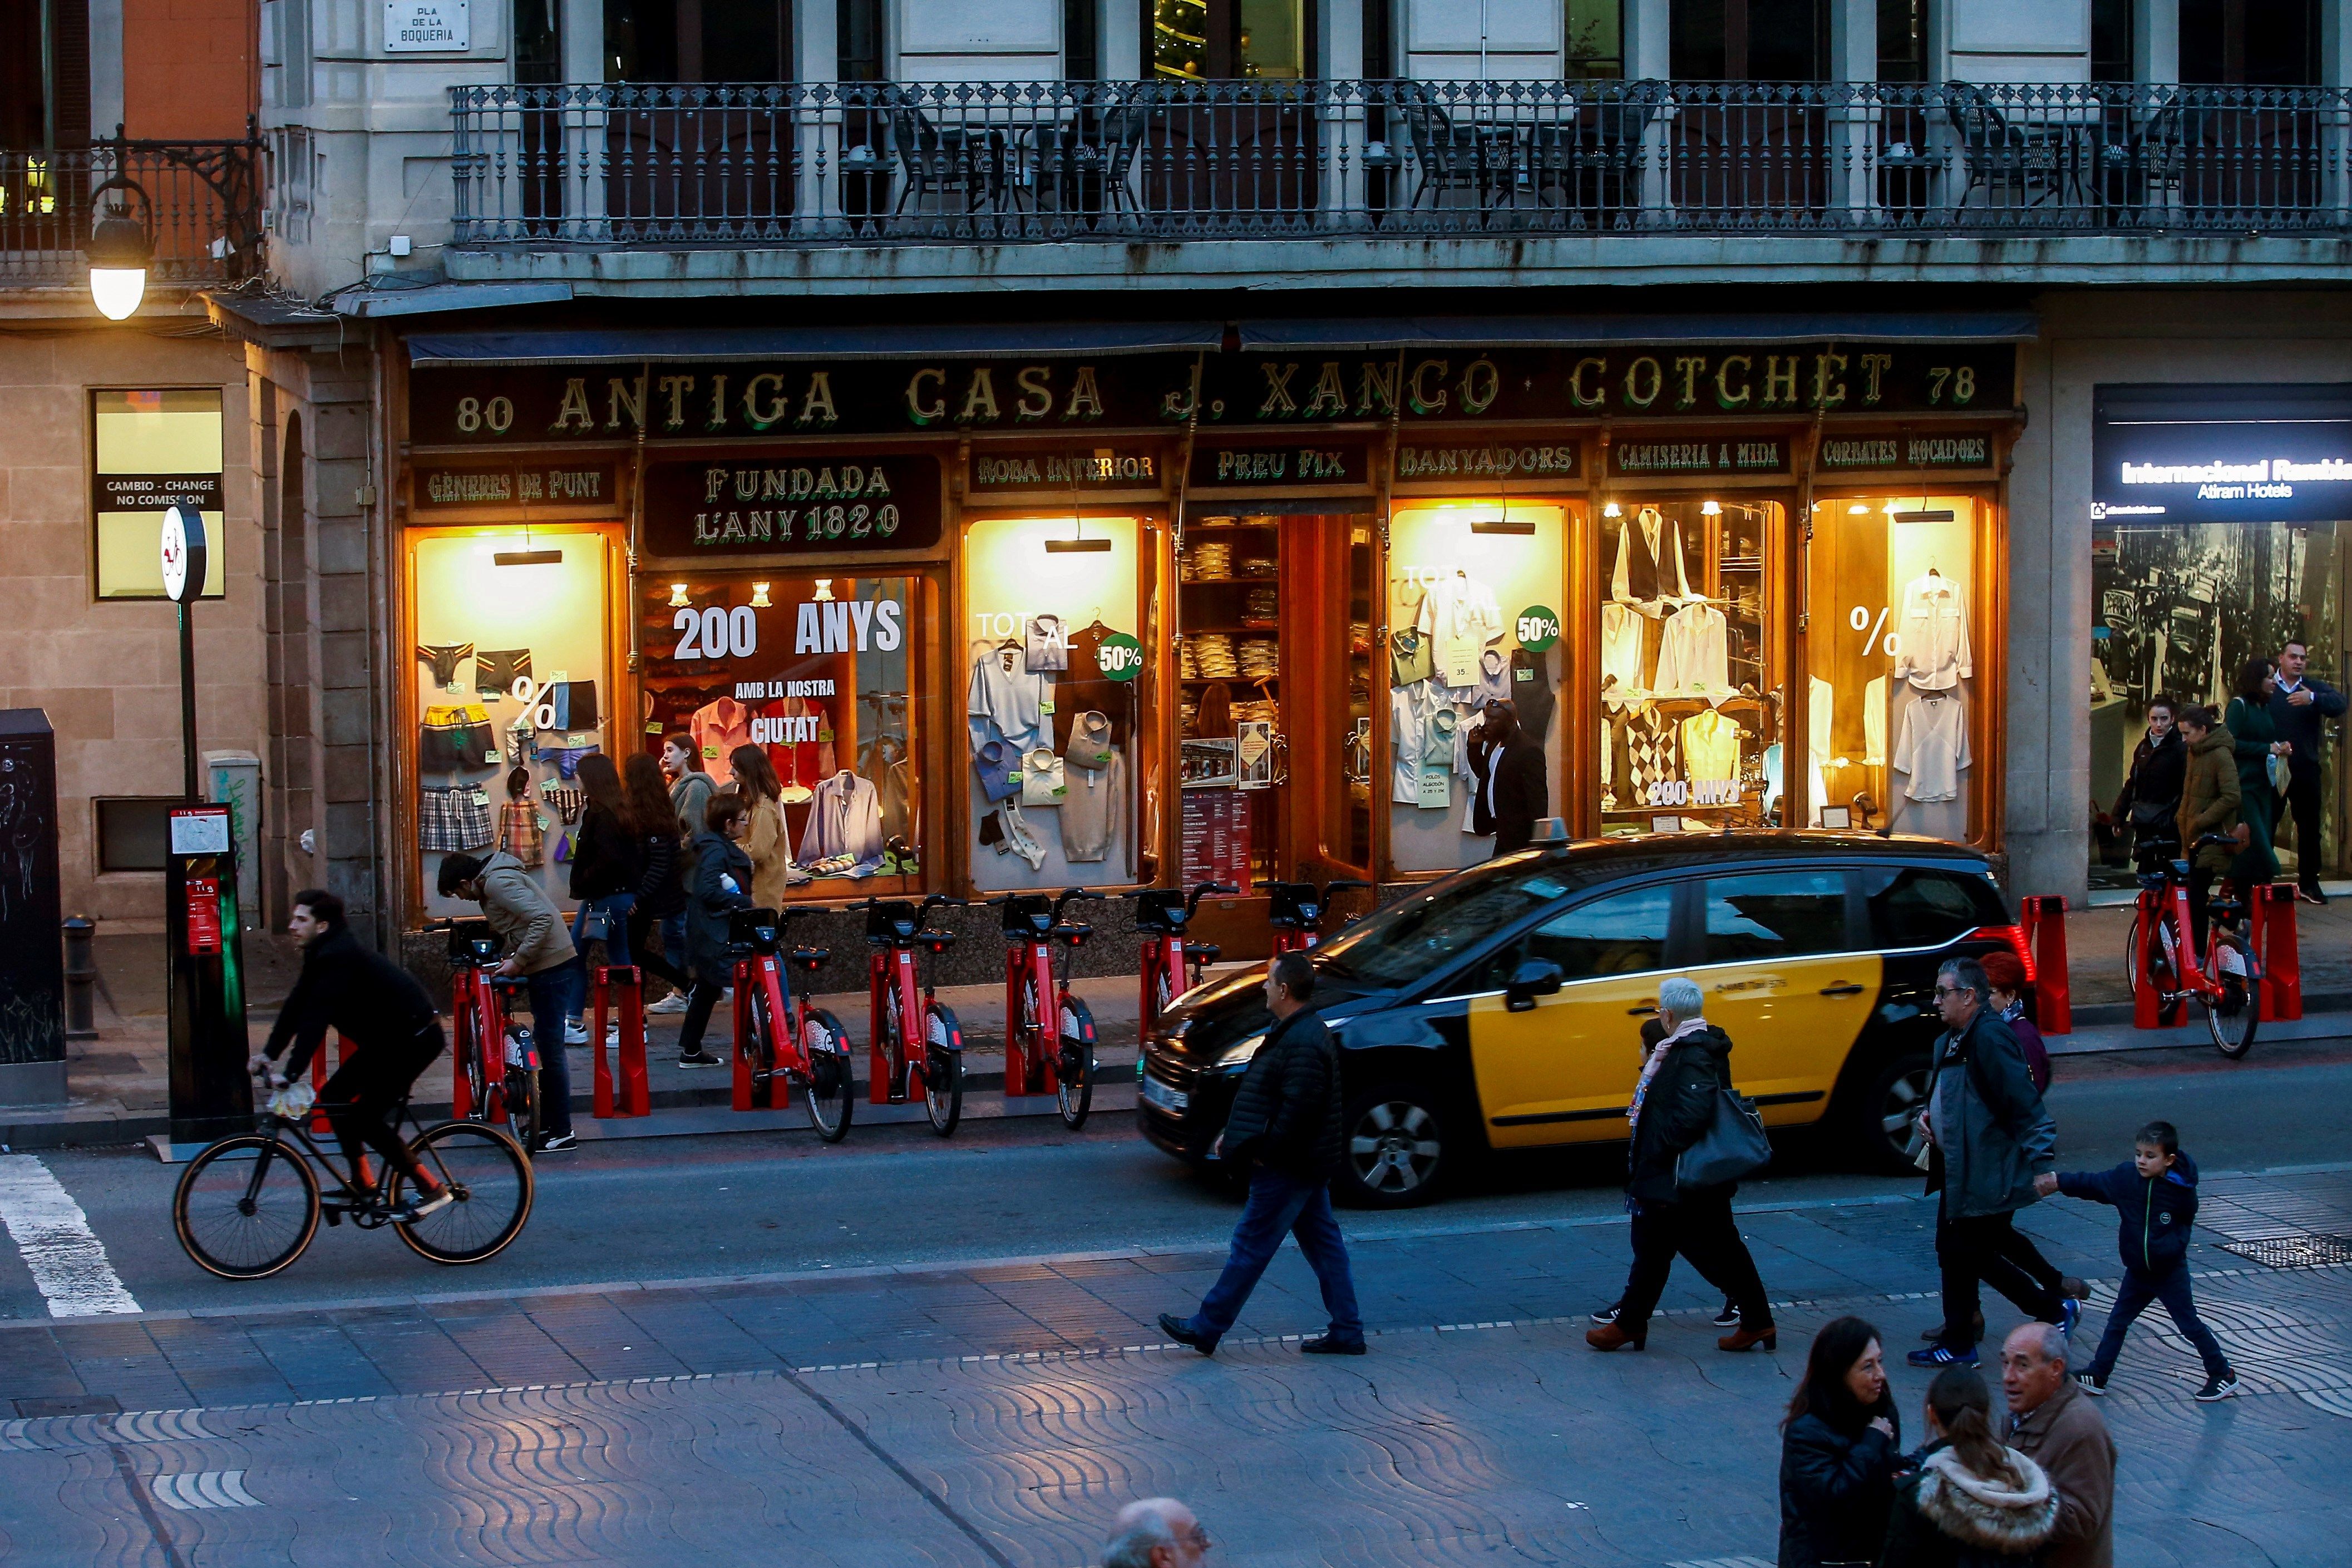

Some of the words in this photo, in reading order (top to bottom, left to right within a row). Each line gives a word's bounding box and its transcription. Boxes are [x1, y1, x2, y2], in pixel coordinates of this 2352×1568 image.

[401, 29, 453, 42] BOQUERIA
[457, 397, 514, 434] 80
[553, 372, 839, 432] ANTIGA
[906, 366, 1104, 423] CASA
[1162, 364, 1226, 417] J.
[1259, 352, 1499, 416] XANCÓ
[1569, 354, 1892, 409] COTCHET
[1930, 367, 1975, 402] 78
[1217, 450, 1286, 480] PREU
[1298, 448, 1346, 478] FIX
[1400, 446, 1572, 477] BANYADORS
[1617, 443, 1711, 470] CAMISERIA
[1718, 445, 1730, 469] A
[1737, 442, 1779, 469] MIDA
[1822, 439, 1897, 466] CORBATES
[1908, 438, 1985, 465] MOCADORS
[978, 457, 1040, 484] ROBA
[1047, 456, 1154, 482] INTERIOR
[106, 481, 154, 491] CAMBIO
[165, 480, 214, 491] CHANGE
[428, 471, 511, 501] GÈNERES
[519, 472, 542, 500] DE
[549, 469, 601, 497] PUNT
[704, 466, 891, 504] FUNDADA
[2197, 483, 2244, 499] Atiram
[2247, 482, 2292, 498] Hotels
[116, 495, 135, 505] NO
[694, 509, 798, 544] L'ANY
[807, 504, 900, 540] 1820
[673, 605, 757, 660] 200
[794, 599, 901, 655] ANYS
[975, 612, 1033, 638] TOT
[1517, 617, 1559, 643] 50%
[1849, 607, 1902, 657] %
[1098, 646, 1142, 672] 50%
[511, 675, 556, 730] %
[734, 682, 765, 700] AMB
[768, 681, 784, 698] LA
[787, 679, 836, 697] NOSTRA
[751, 716, 820, 744] CIUTAT
[1649, 780, 1688, 807] 200
[1692, 778, 1740, 805] ANYS
